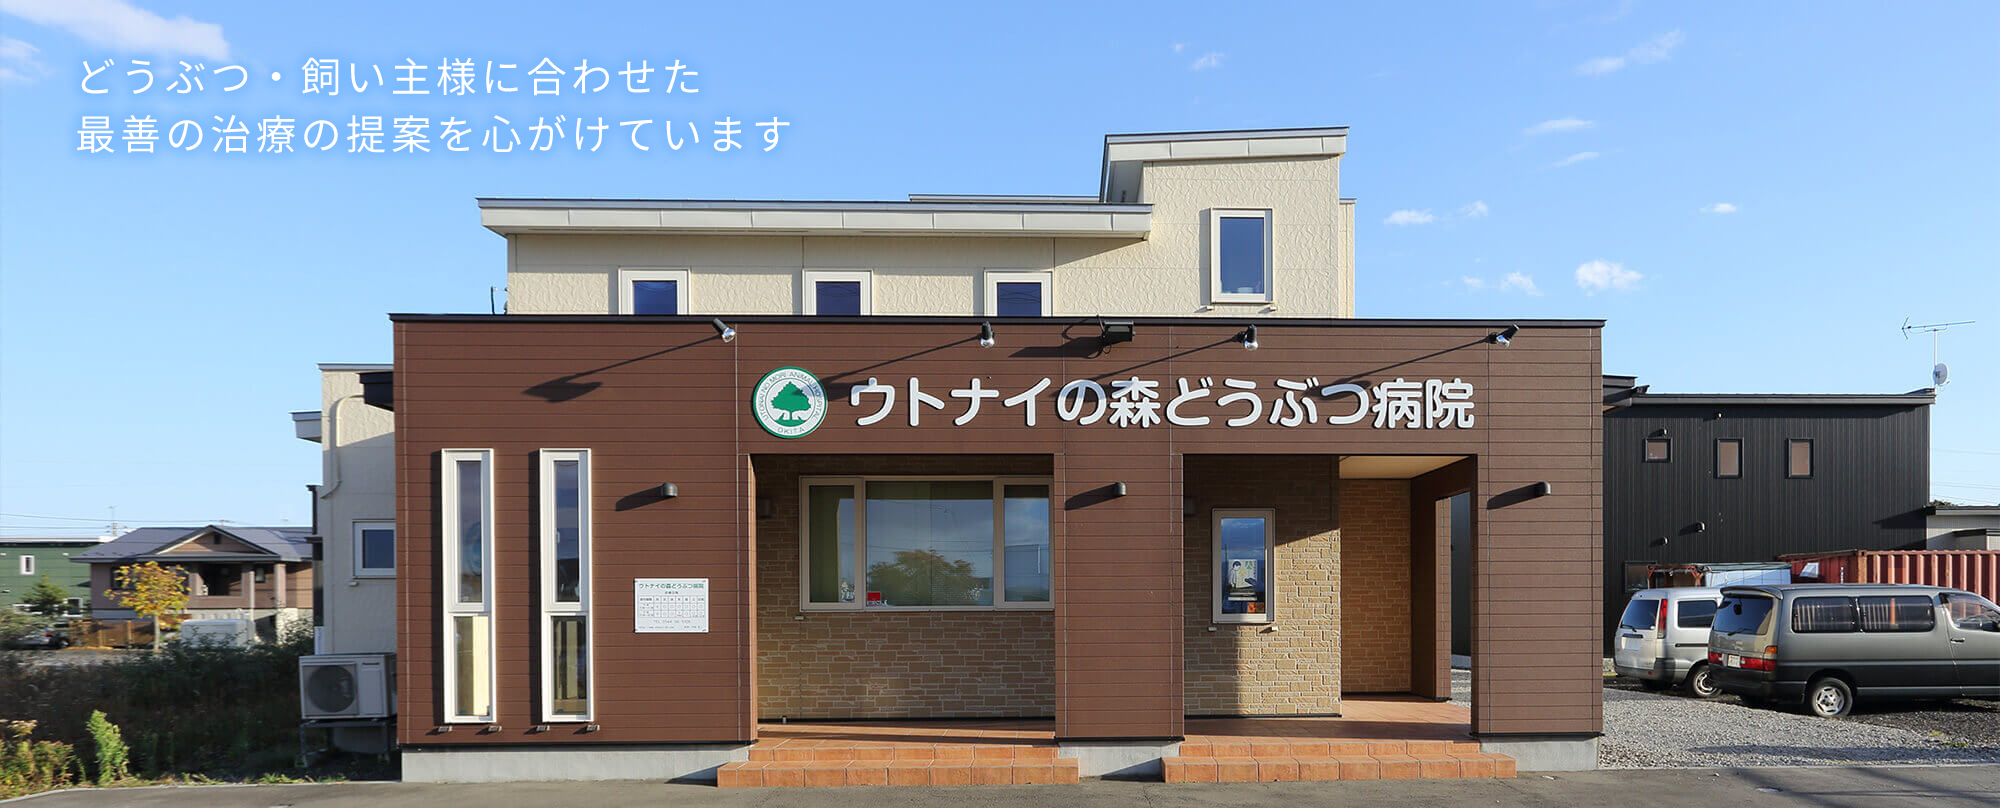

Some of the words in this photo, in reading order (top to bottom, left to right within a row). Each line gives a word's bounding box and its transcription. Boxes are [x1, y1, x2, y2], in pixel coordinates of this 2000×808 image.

[851, 377, 1474, 429] ウトナイの森どうぶつ病院
[777, 426, 805, 435] OKITA
